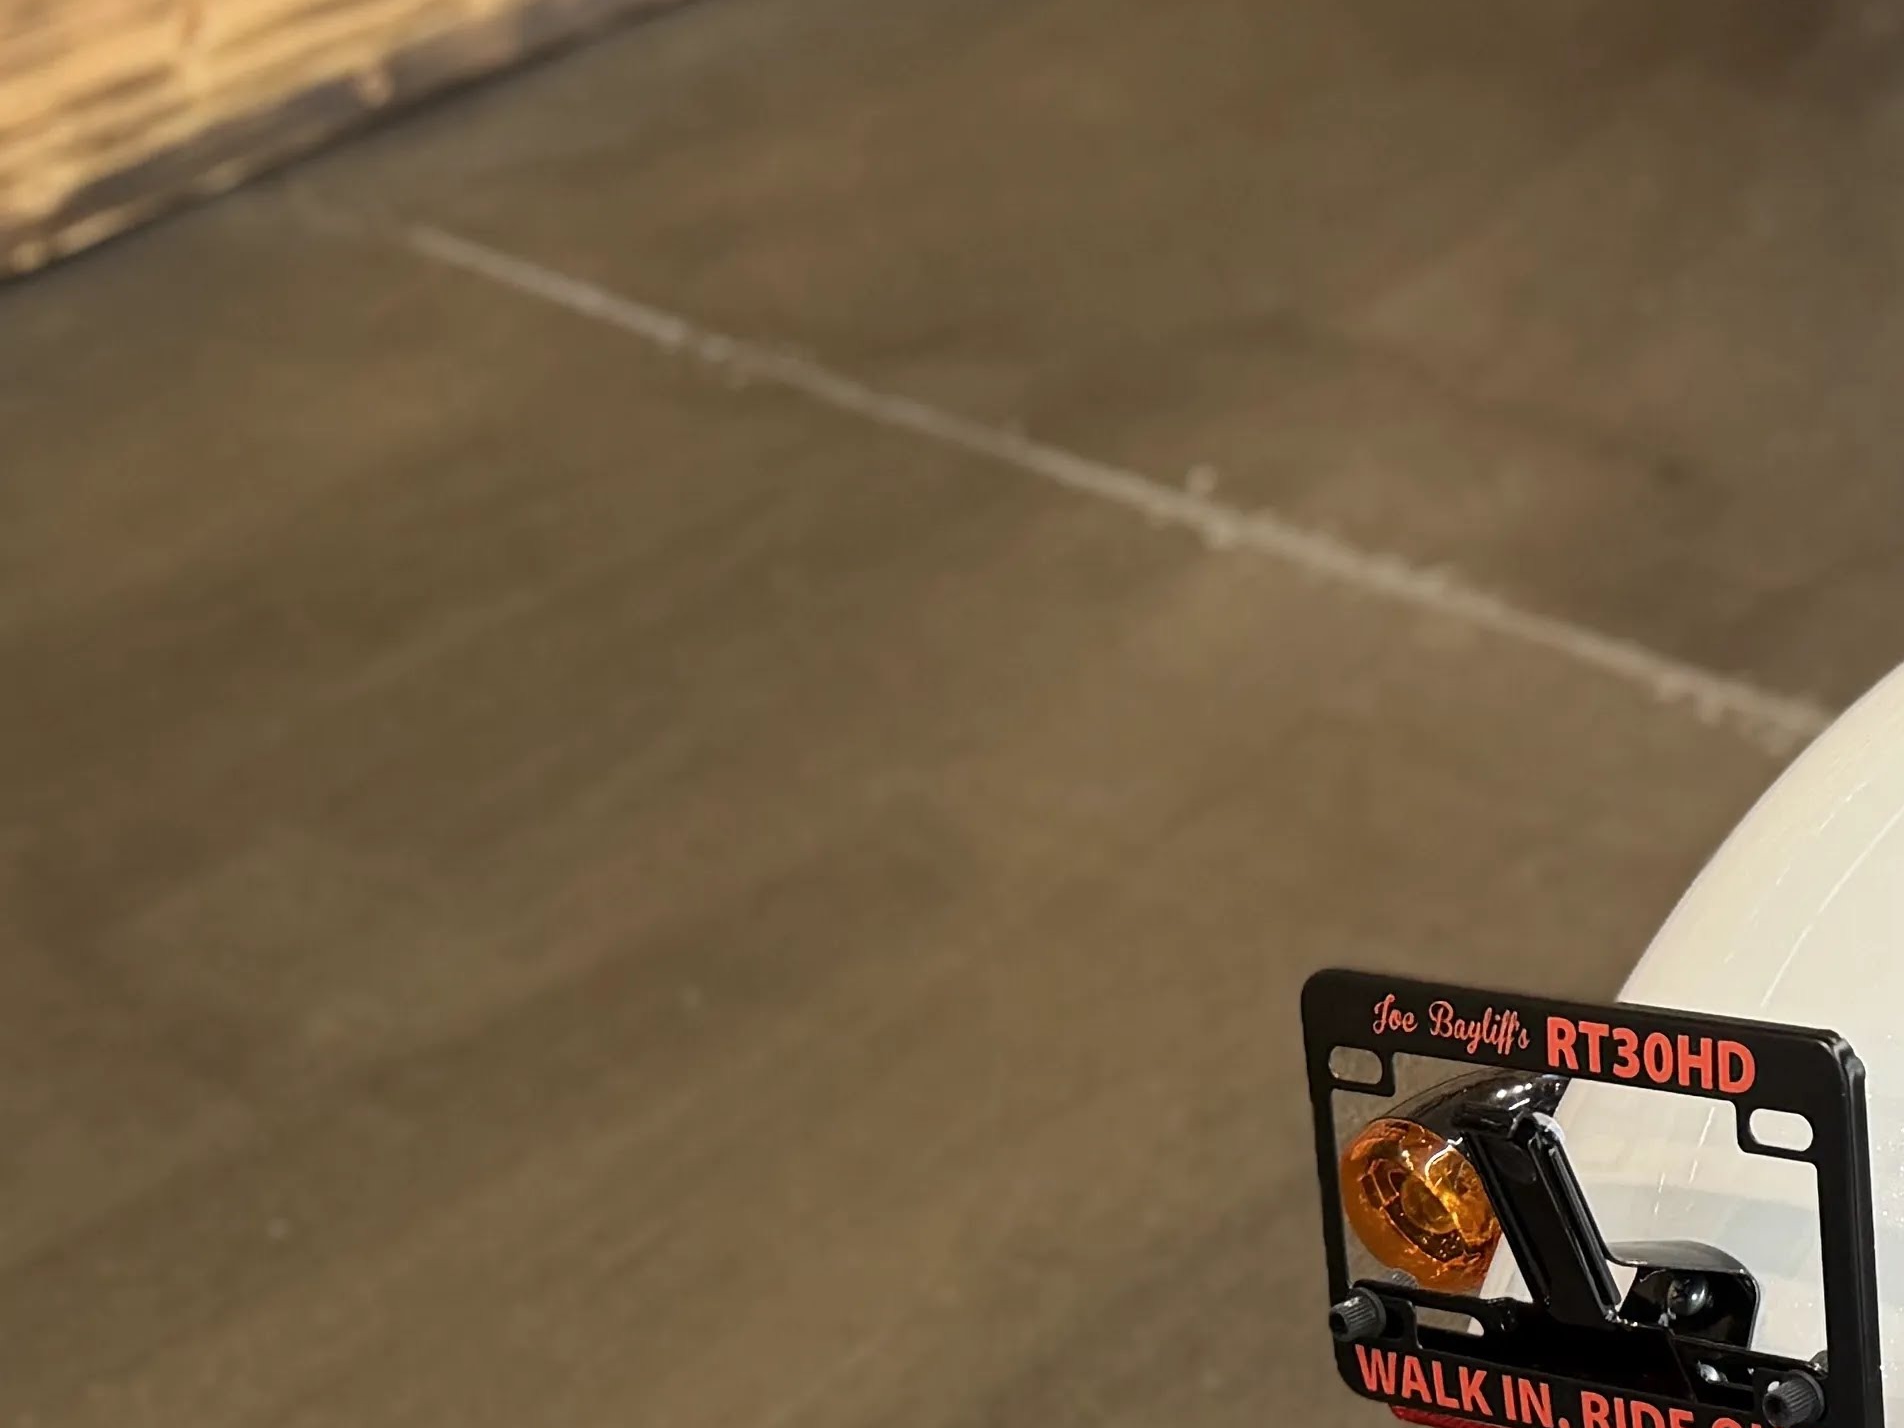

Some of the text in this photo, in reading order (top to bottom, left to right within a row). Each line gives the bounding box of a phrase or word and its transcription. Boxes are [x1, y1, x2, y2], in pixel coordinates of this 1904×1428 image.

[1372, 993, 1757, 1095] Joe Bayliff's RT30HD
[1355, 1345, 1492, 1417] WALK
